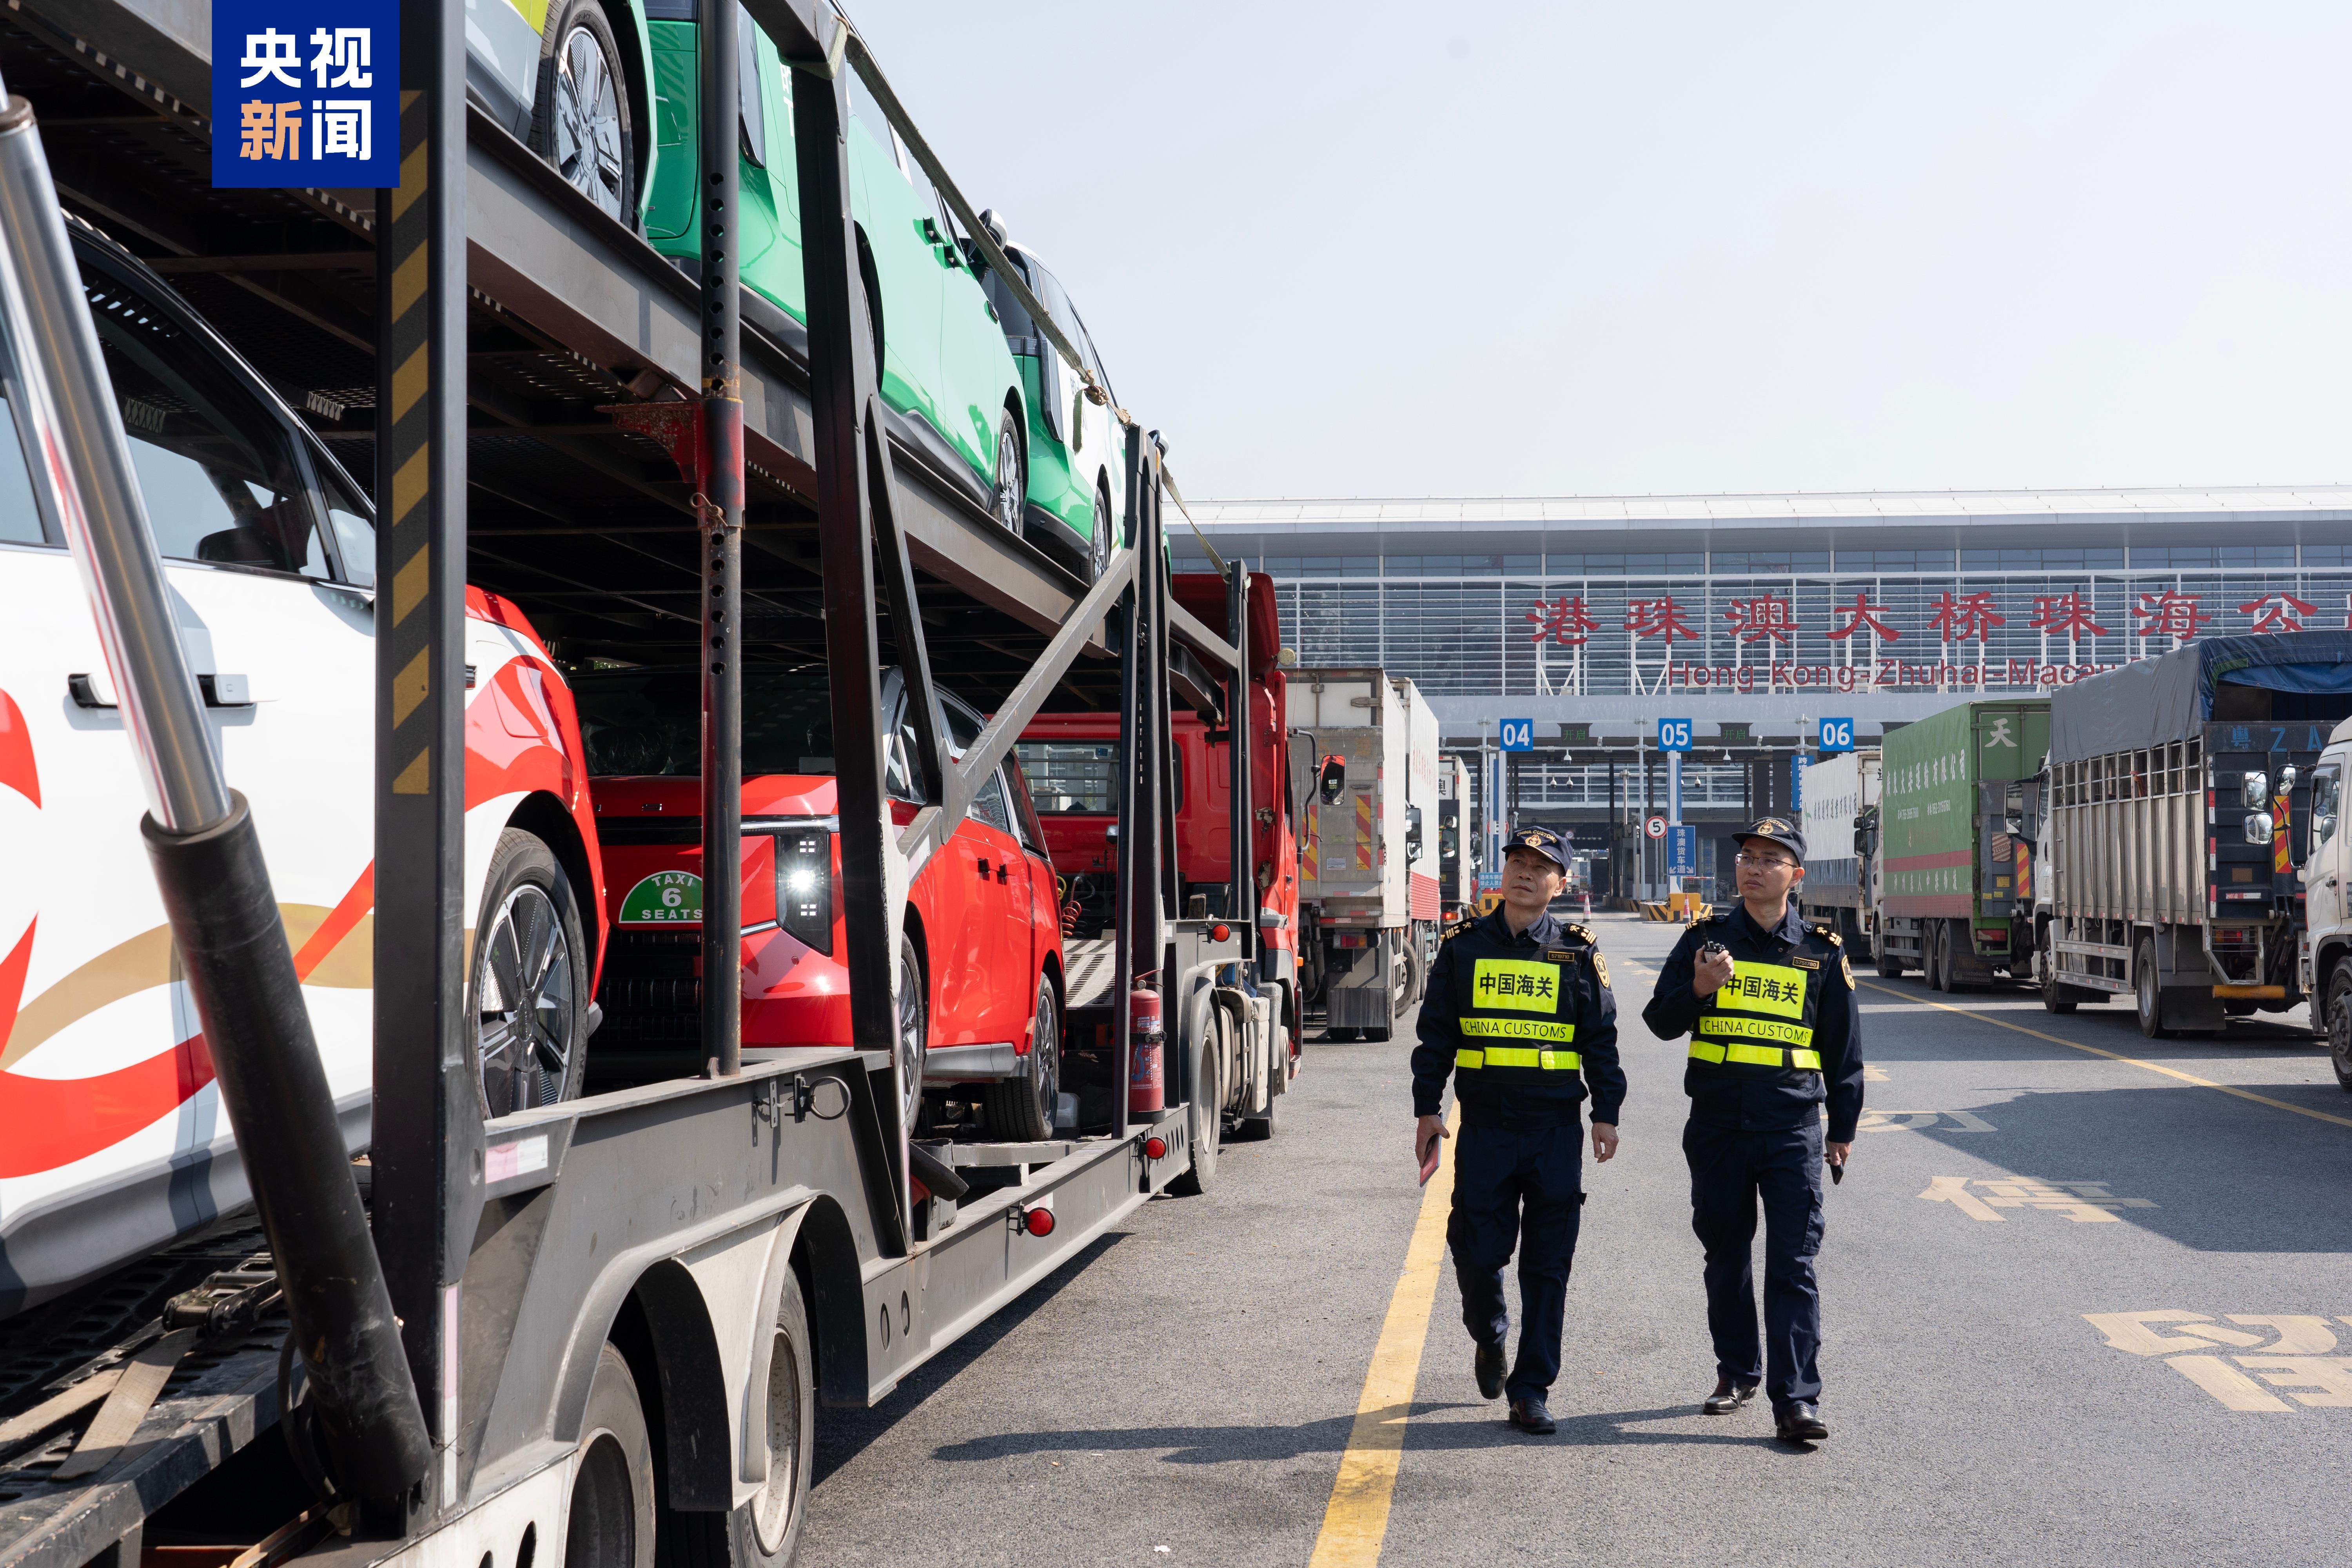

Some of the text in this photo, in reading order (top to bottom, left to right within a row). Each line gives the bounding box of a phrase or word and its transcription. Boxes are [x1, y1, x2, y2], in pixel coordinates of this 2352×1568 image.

[1525, 589, 2352, 645] 港珠澳大桥珠海公
[1668, 661, 1753, 692] Hong
[1503, 723, 1530, 746] 04
[1563, 729, 1586, 741] 开启
[1661, 723, 1688, 746] 05
[1724, 728, 1746, 740] 开启
[1823, 723, 1850, 746] 06
[1984, 717, 2018, 748] 天
[1653, 821, 1661, 833] 5
[1766, 818, 1789, 831] CUSTOMS
[1533, 830, 1557, 843] CUSTOMS
[1677, 828, 1686, 874] 珠澳货车道
[1993, 843, 2009, 854] ZEPRO
[651, 874, 693, 887] TAXI
[662, 887, 681, 907] 6
[642, 909, 702, 919] SEATS
[1479, 971, 1553, 999] 中国海关
[1724, 974, 1799, 1004] 中国海关
[1464, 1020, 1567, 1039] CHINA CUSTOMS
[1704, 1018, 1811, 1044] CHINA CUSTOMS
